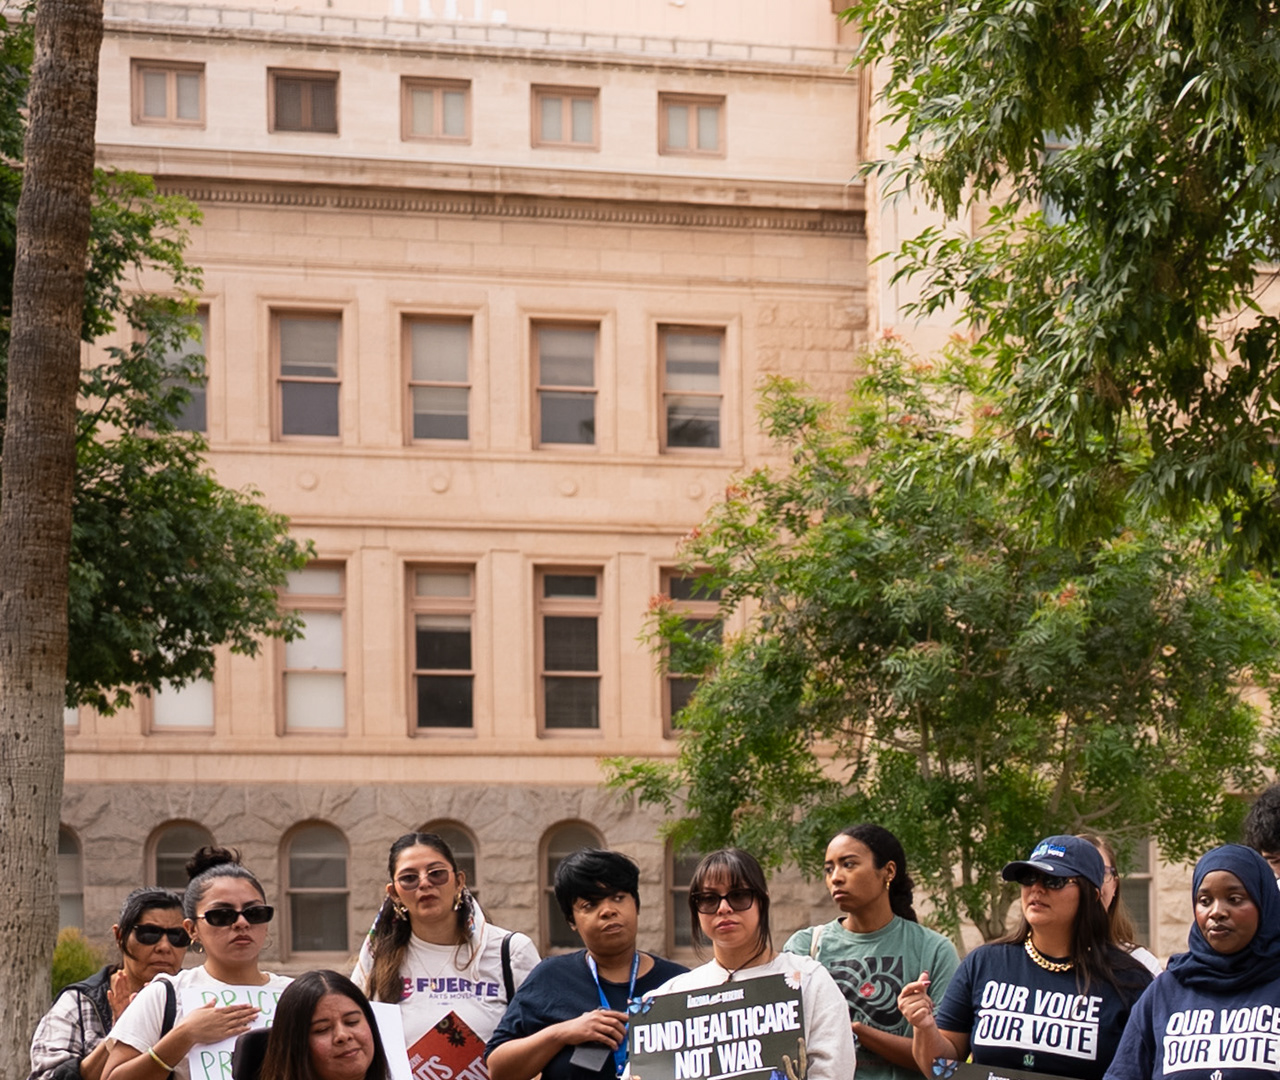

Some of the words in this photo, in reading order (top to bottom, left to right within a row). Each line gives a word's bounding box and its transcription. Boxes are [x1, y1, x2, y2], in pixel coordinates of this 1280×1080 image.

[416, 977, 500, 997] FUERTE
[980, 980, 1030, 1013] OUR
[1033, 988, 1103, 1023] VOICE
[633, 1020, 684, 1055] FUND
[685, 999, 801, 1048] HEALTHCARE
[979, 1013, 1024, 1043] OUR
[1031, 1019, 1093, 1055] VOTE
[1165, 1008, 1215, 1036] OUR
[674, 1047, 713, 1080] NOT
[716, 1039, 764, 1074] WAR
[1168, 1040, 1211, 1067] OUR
[1218, 1037, 1278, 1065] VOTE
